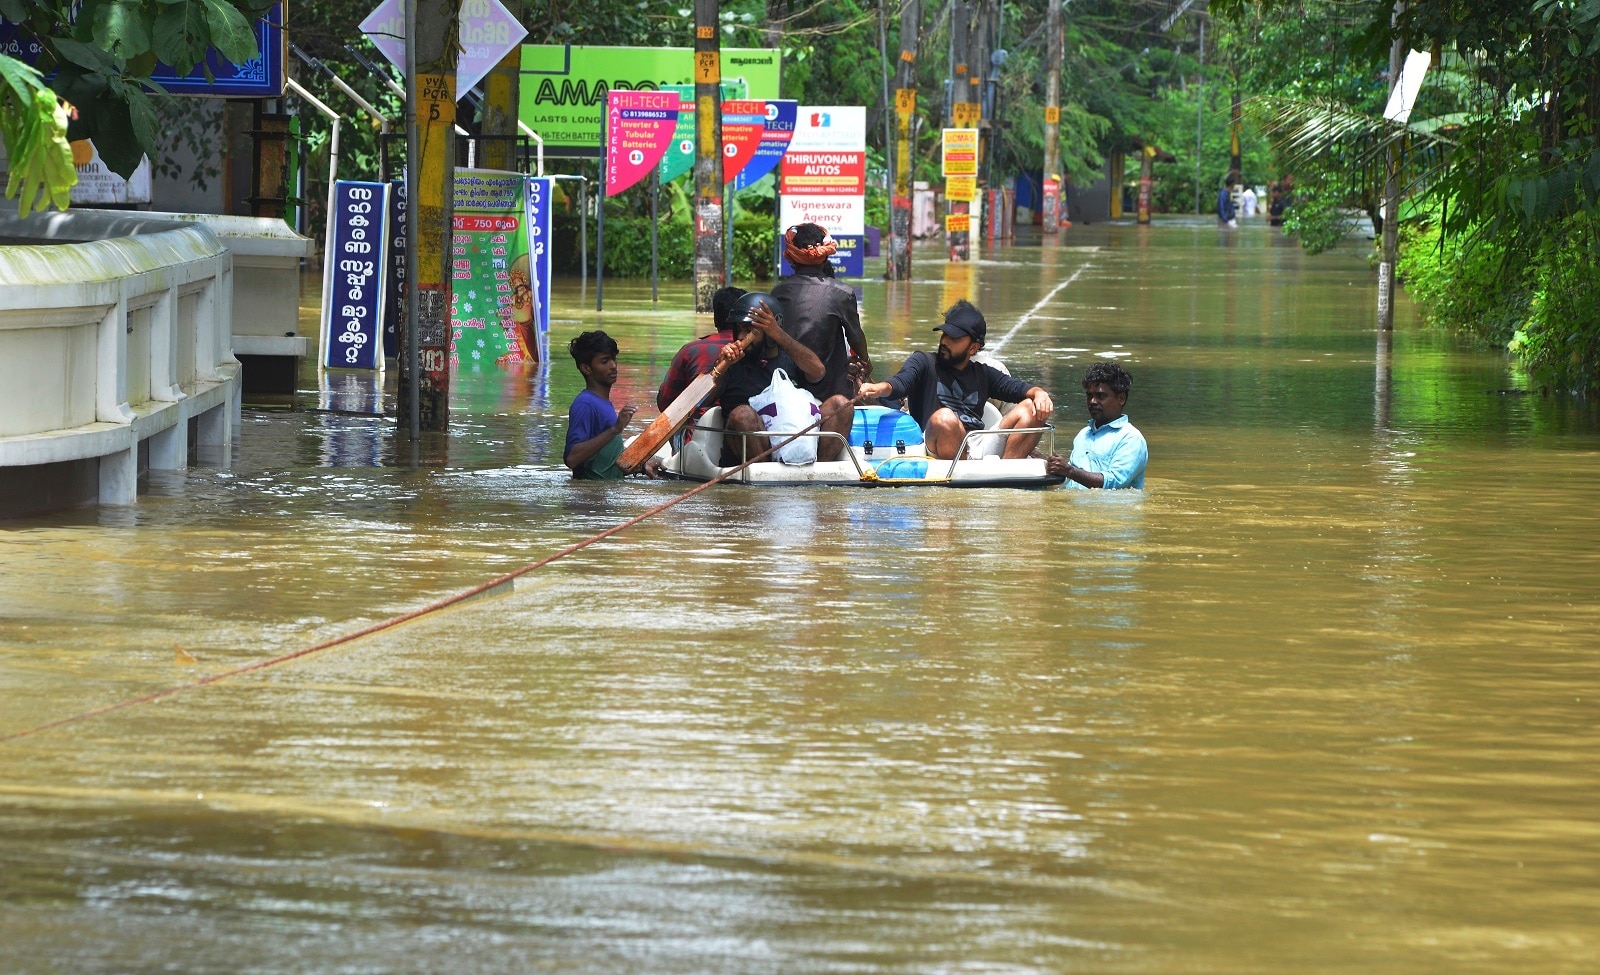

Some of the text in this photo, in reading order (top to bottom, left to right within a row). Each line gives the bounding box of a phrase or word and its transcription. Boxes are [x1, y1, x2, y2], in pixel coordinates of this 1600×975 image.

[703, 69, 709, 78] 7
[423, 88, 448, 100] PCR
[620, 96, 668, 108] HI-TECH
[430, 104, 440, 120] 5
[542, 131, 572, 139] HI-TECH
[610, 97, 619, 184] BATTERIES
[785, 154, 858, 164] THIRUVONAM
[804, 166, 840, 175] AUTOS
[791, 201, 851, 211] Vigneswara
[344, 187, 372, 254] സഹകരണ
[803, 213, 842, 223] Agency
[474, 220, 492, 228] 750
[496, 220, 515, 229] രൂപ
[340, 259, 373, 300] സൂപ്പർ
